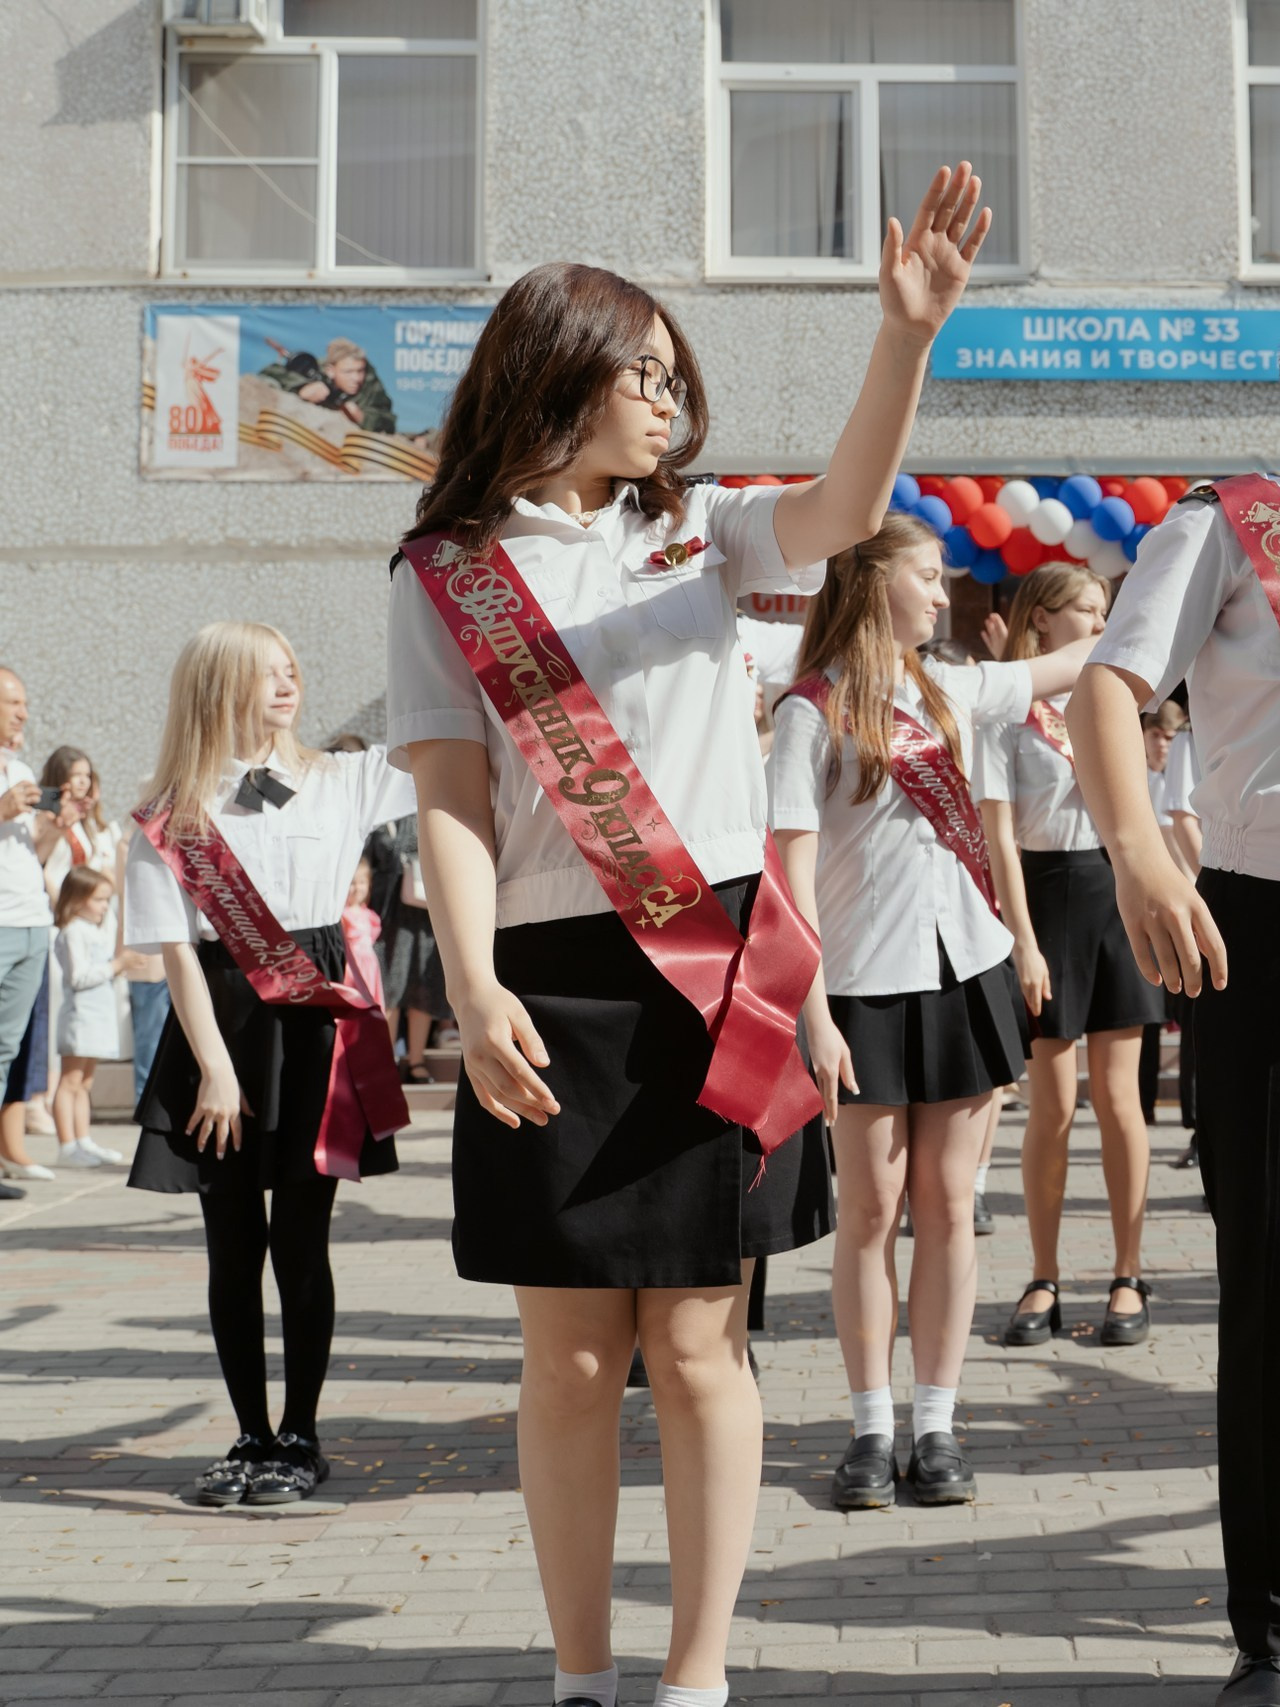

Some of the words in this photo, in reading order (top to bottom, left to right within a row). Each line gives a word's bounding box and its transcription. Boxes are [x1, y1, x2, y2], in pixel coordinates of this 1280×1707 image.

[1023, 317, 1151, 342] ШКОЛА
[1159, 316, 1195, 343] №
[1203, 318, 1240, 343] 33
[956, 347, 1081, 369] ЗНАНИЯ
[1091, 348, 1110, 369] И
[558, 768, 631, 807] 9
